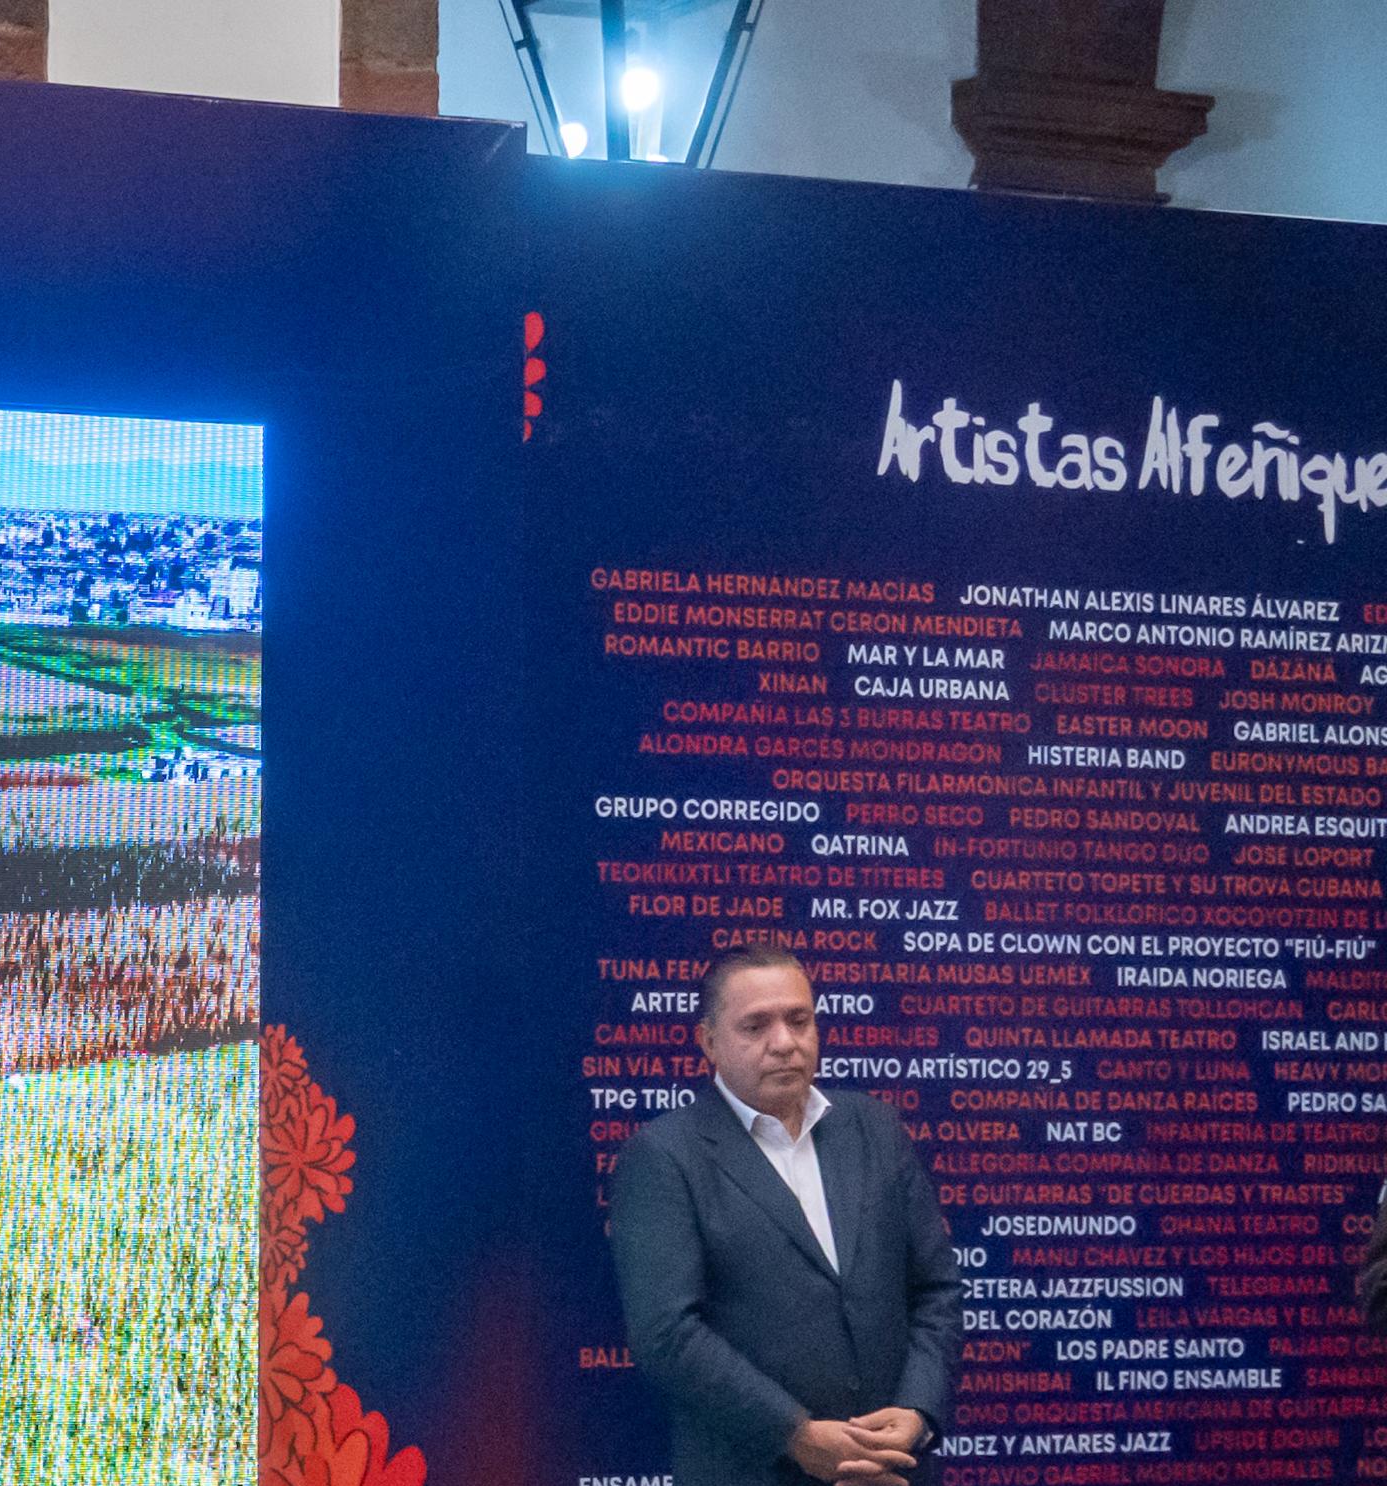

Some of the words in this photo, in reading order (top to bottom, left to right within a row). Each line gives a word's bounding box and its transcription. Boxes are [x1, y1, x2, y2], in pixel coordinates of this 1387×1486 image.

[877, 378, 1127, 491] Artistas
[960, 585, 1079, 610] JONATHAN
[1085, 592, 1154, 613] ALEXIS
[1161, 595, 1246, 617] LINARES
[1252, 594, 1339, 621] ÁLVAREZ
[1049, 621, 1130, 643] MARCO
[1137, 625, 1233, 648] ANTONIO
[1241, 626, 1331, 652] RAMÍREZ
[848, 645, 896, 665] MAR
[905, 647, 916, 666] Y
[924, 648, 948, 667] LA
[955, 648, 1004, 669] MAR
[855, 676, 913, 697] CAJA
[920, 678, 1009, 700] URBANA
[1234, 721, 1319, 743] GABRIEL
[1029, 746, 1121, 767] HISTERIA
[1127, 749, 1185, 770] BAND
[1151, 781, 1161, 799] Y
[1260, 784, 1293, 803] DEL
[596, 798, 677, 819] GRUPO
[683, 800, 820, 822] CORREGIDO
[1225, 814, 1309, 835] ANDREA
[812, 835, 908, 857] QATRINA
[829, 867, 855, 886] DE
[1173, 874, 1184, 893] Y
[693, 896, 720, 916] DE
[812, 899, 852, 918] MR.
[859, 899, 899, 919] FOX
[906, 900, 958, 921] JAZZ
[904, 932, 961, 952] SOPA
[968, 932, 994, 953] DE
[1001, 934, 1081, 954] CLOWN
[1087, 935, 1135, 955] CON
[1142, 936, 1163, 955] EL
[1169, 936, 1279, 958] PROYECTO
[1118, 968, 1187, 987] IRAIDA
[1193, 969, 1286, 988] NORIEGA
[632, 992, 699, 1012] ARTEF
[815, 994, 873, 1014] ATRO
[1262, 1031, 1330, 1050] ISRAEL
[1335, 1032, 1378, 1050] AND
[907, 1053, 1020, 1078] ARTÍSTICO
[592, 1089, 637, 1109] TPG
[1047, 1122, 1087, 1141] NAT
[1094, 1122, 1121, 1141] BC
[982, 1215, 1135, 1237] JOSEDMUNDO
[1042, 1277, 1183, 1297] JAZZFUSSION
[963, 1310, 1000, 1330] DEL
[1006, 1304, 1111, 1330] CORAZÓN
[1057, 1340, 1096, 1361] LOS
[1103, 1339, 1168, 1360] PADRE
[1174, 1338, 1244, 1358] SANTO
[1097, 1371, 1113, 1391] IL
[1119, 1370, 1167, 1390] FINO
[1174, 1368, 1281, 1390] ENSAMBLE
[1003, 1435, 1015, 1454] Y
[1021, 1433, 1115, 1454] ANTARES
[1121, 1432, 1171, 1452] JAZZ
